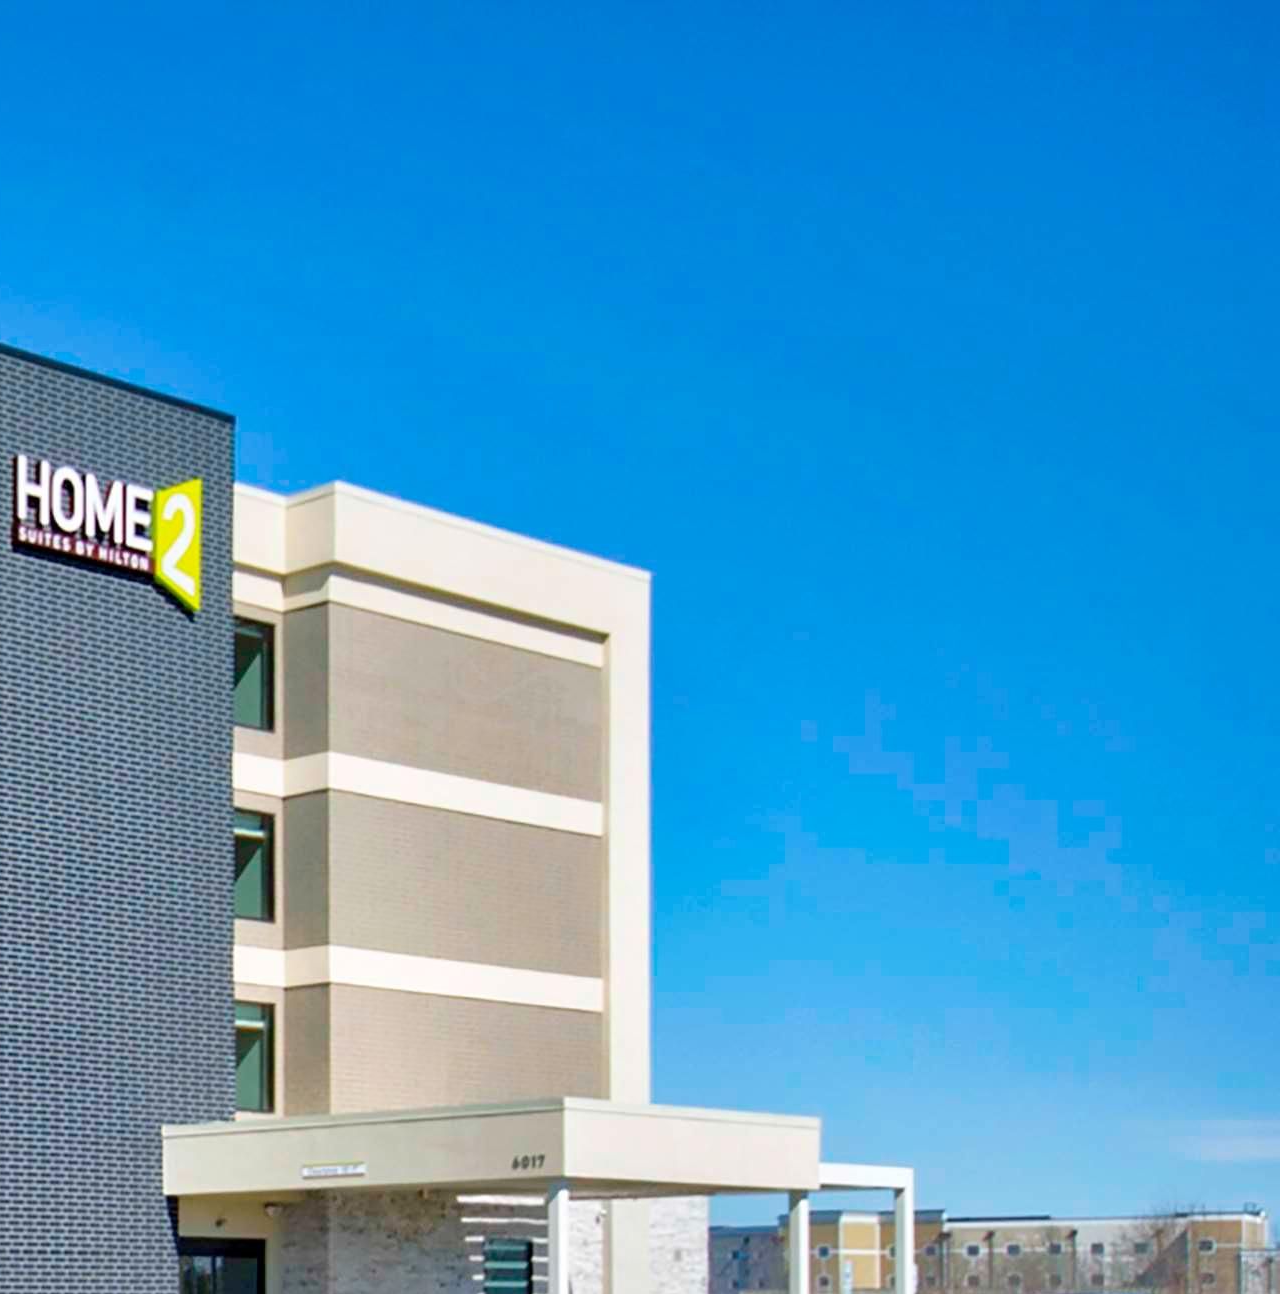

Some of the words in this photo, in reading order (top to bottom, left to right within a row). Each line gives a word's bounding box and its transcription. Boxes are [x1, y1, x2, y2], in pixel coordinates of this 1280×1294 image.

[18, 526, 71, 553] SUITES
[75, 540, 95, 559] BY
[99, 545, 149, 571] HILTON
[511, 1154, 546, 1170] 6017
